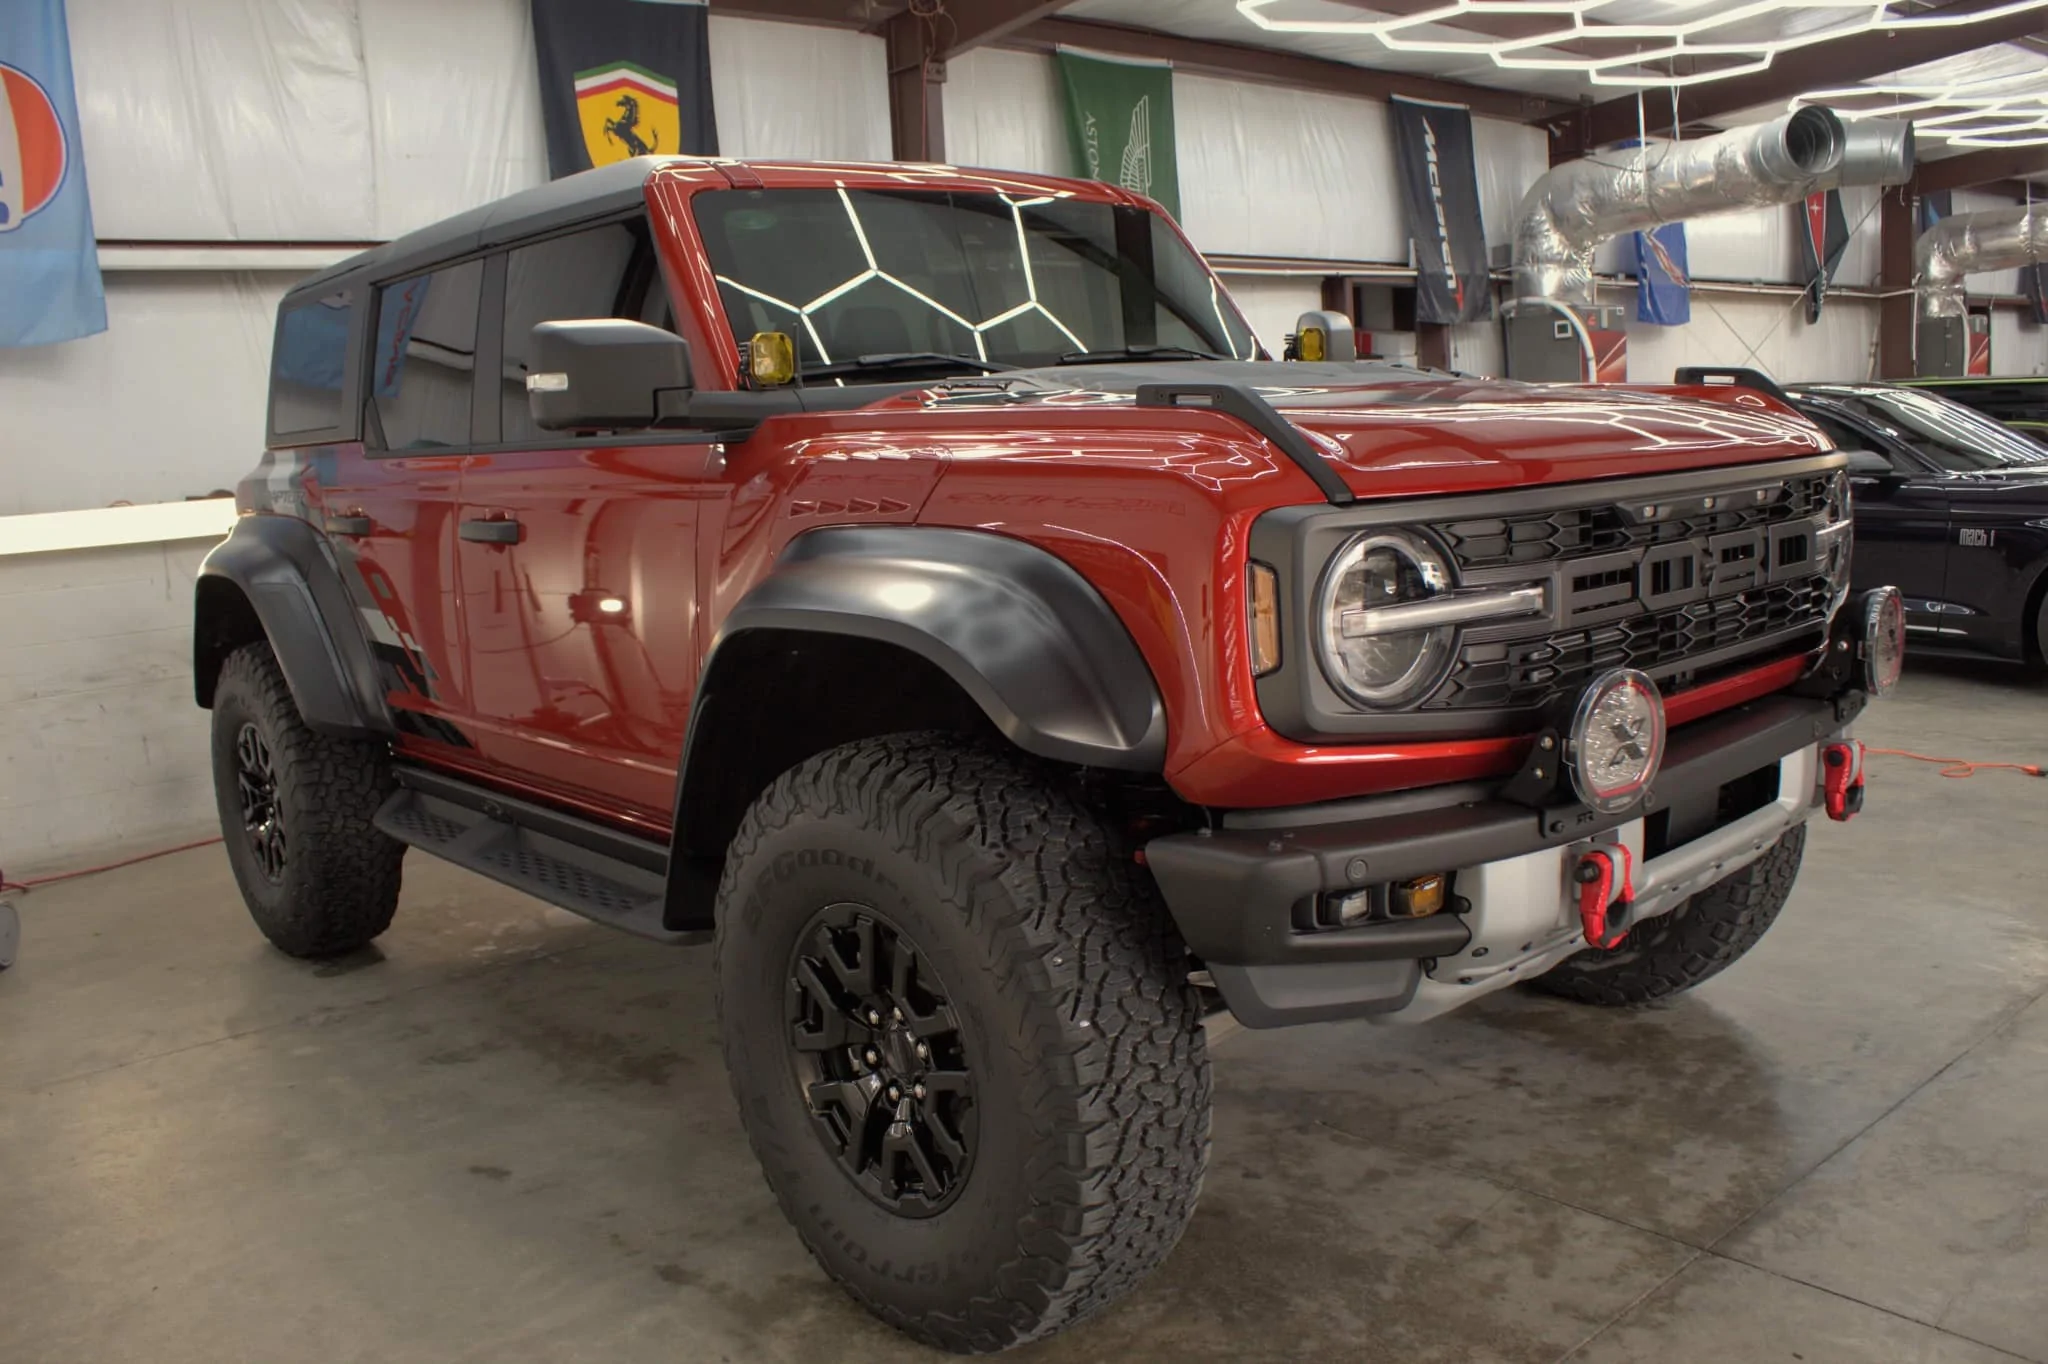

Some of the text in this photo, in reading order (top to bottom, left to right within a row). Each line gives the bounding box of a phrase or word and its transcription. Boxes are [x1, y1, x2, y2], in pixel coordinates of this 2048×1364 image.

[1084, 110, 1101, 181] ASTON
[1421, 115, 1458, 290] McLaren
[1562, 517, 1817, 628] FORD
